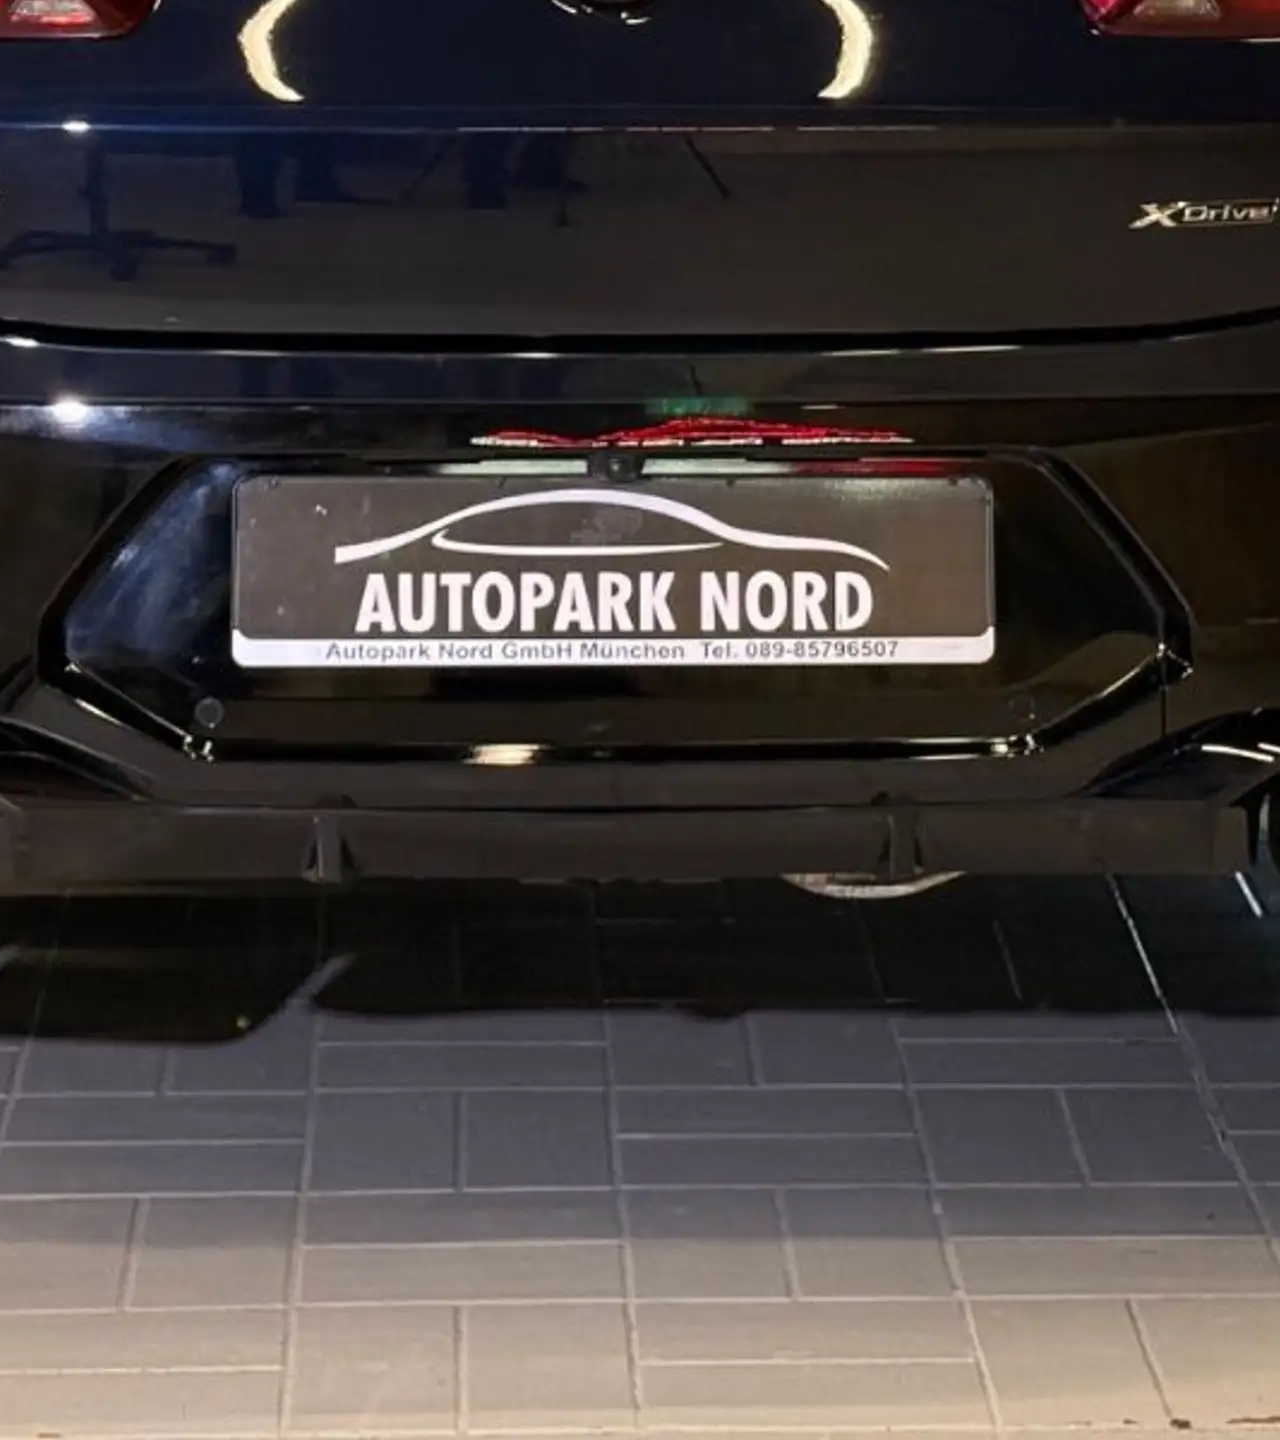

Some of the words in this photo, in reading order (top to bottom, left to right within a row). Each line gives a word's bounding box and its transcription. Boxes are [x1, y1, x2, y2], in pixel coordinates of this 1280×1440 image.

[355, 570, 676, 633] AUTOPARK
[700, 570, 873, 632] NORD
[325, 642, 431, 664] Autopark
[438, 641, 493, 661] Nord
[501, 640, 573, 661] GmbH
[579, 639, 685, 661] München
[700, 641, 738, 660] Tel.
[745, 640, 899, 659] 089-85796507
